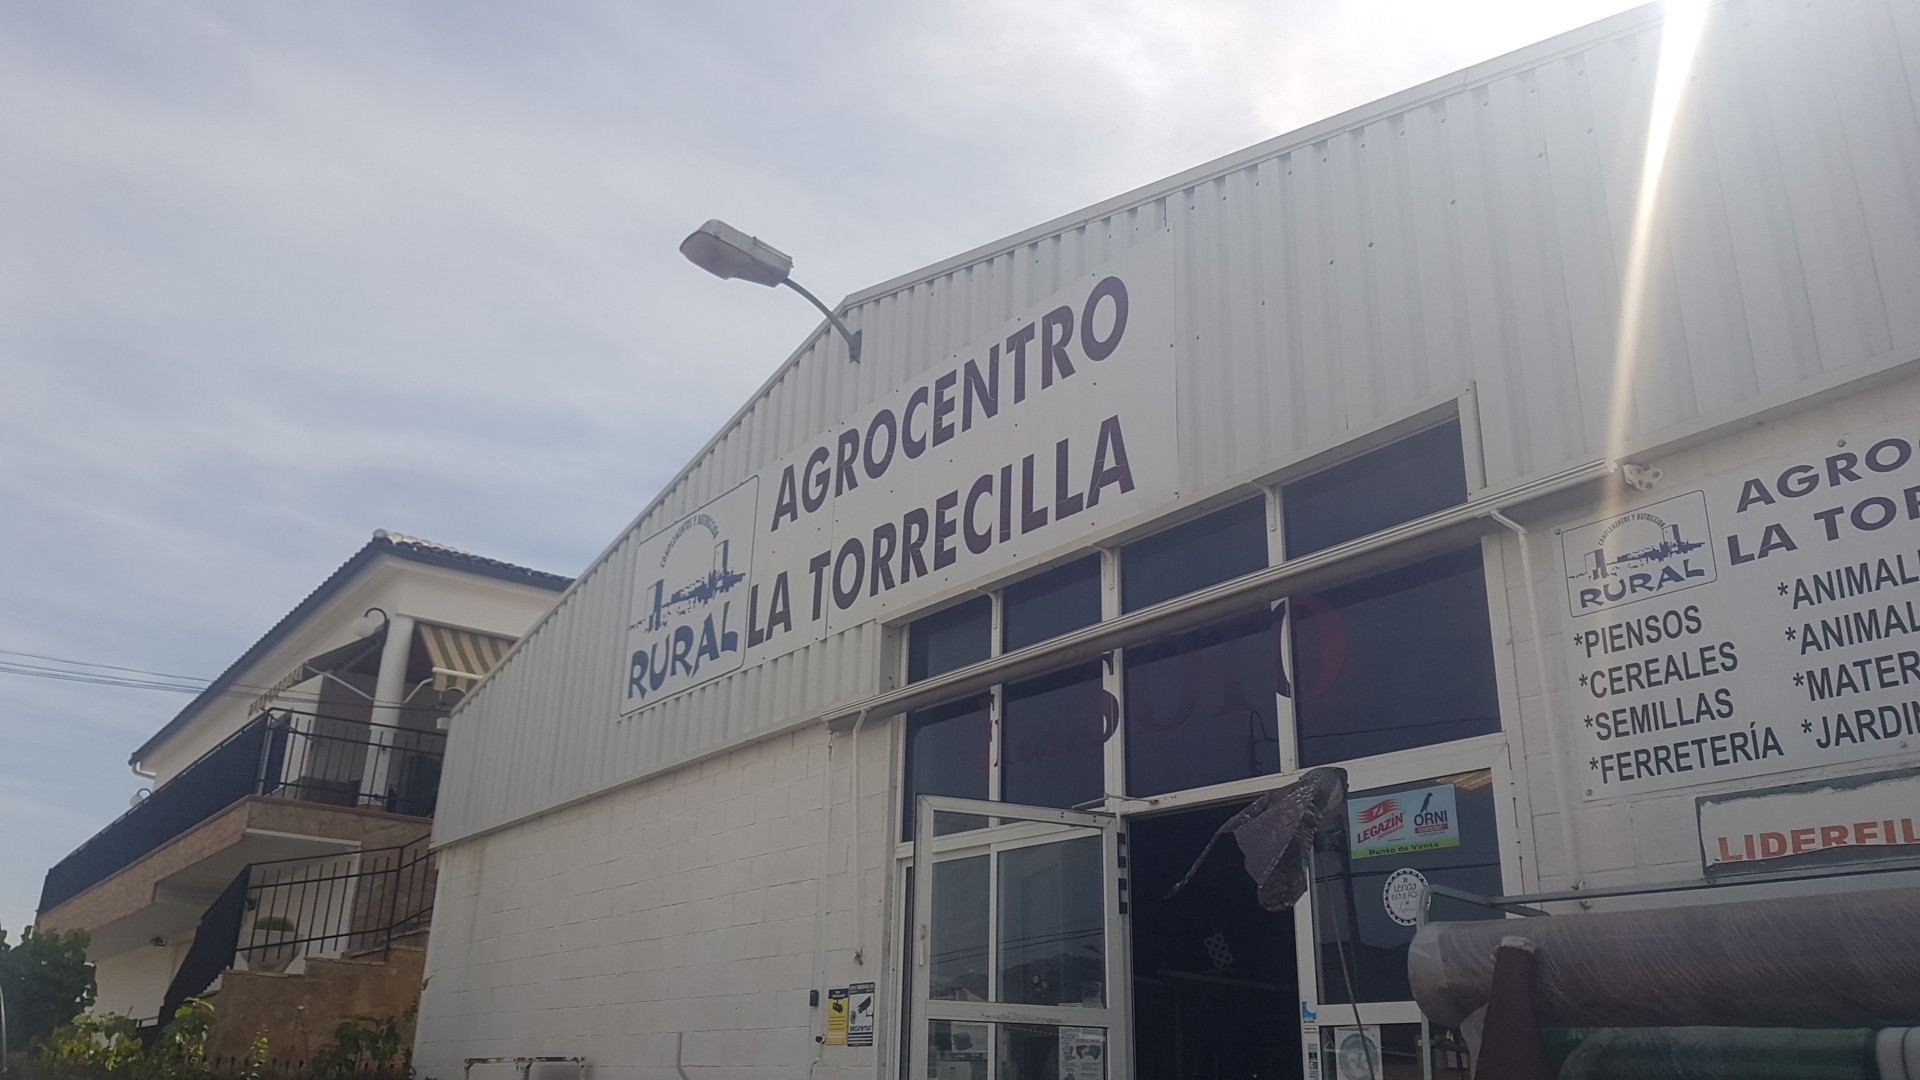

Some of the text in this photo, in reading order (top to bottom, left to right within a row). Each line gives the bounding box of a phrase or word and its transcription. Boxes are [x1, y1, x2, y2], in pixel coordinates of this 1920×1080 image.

[771, 276, 1129, 532] AGROCENTRO
[1736, 438, 1920, 513] AGRO
[660, 518, 692, 568] COMPLEMENTOS
[747, 415, 1136, 649] LA TORRECILLA
[1598, 515, 1631, 545] COMPLEMENTOS
[1727, 523, 1798, 566] LA
[1579, 558, 1705, 609] RURAL
[1777, 549, 1920, 610] ANIMAL
[628, 601, 739, 699] RURAL
[1357, 812, 1403, 844] LEGAZÍN
[1414, 810, 1448, 827] ORNI
[1369, 842, 1440, 855] Punto de Venta
